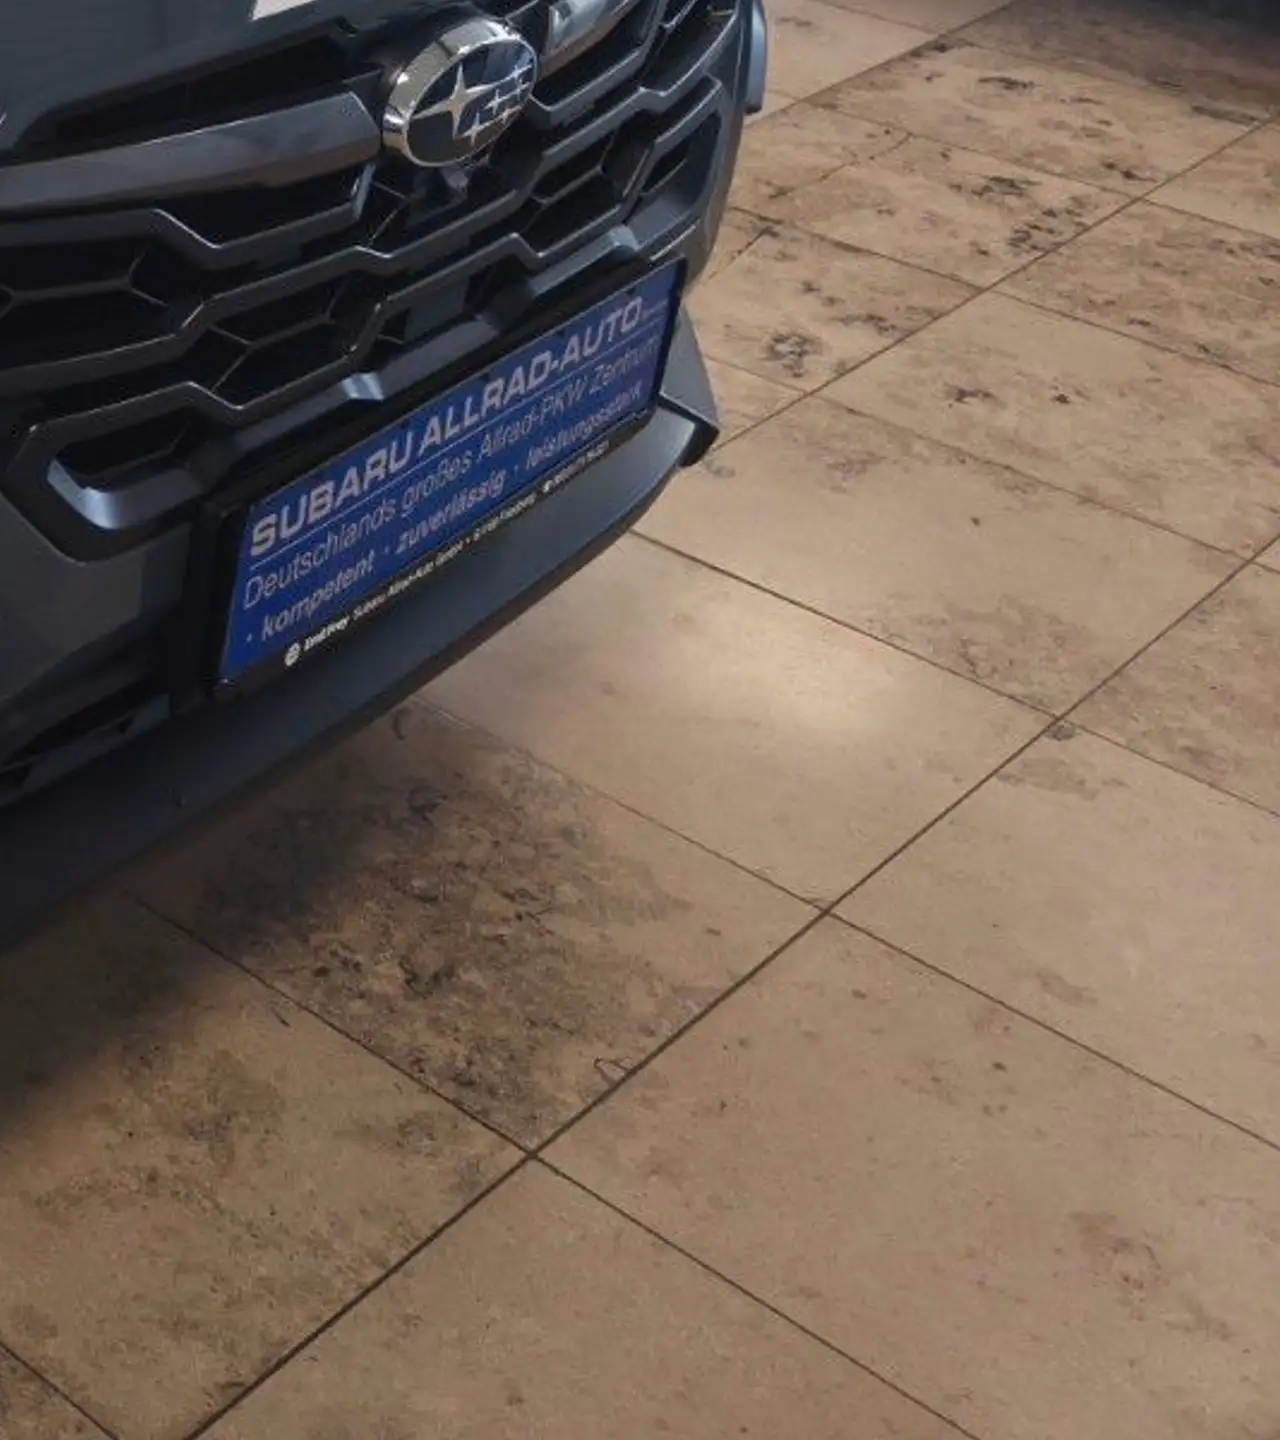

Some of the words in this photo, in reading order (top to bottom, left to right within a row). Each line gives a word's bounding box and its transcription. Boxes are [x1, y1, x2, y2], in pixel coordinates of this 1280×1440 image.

[243, 496, 396, 610] Deutschlands
[401, 450, 473, 519] großes
[476, 375, 589, 462] Allrad-PKW
[590, 334, 662, 395] Zentrum
[250, 430, 414, 557] SUBARU
[418, 296, 644, 457] ALLRAD-AUTO
[262, 549, 376, 641] kompetent
[395, 468, 507, 555] zuverlässig
[525, 379, 642, 471] leistungsstark
